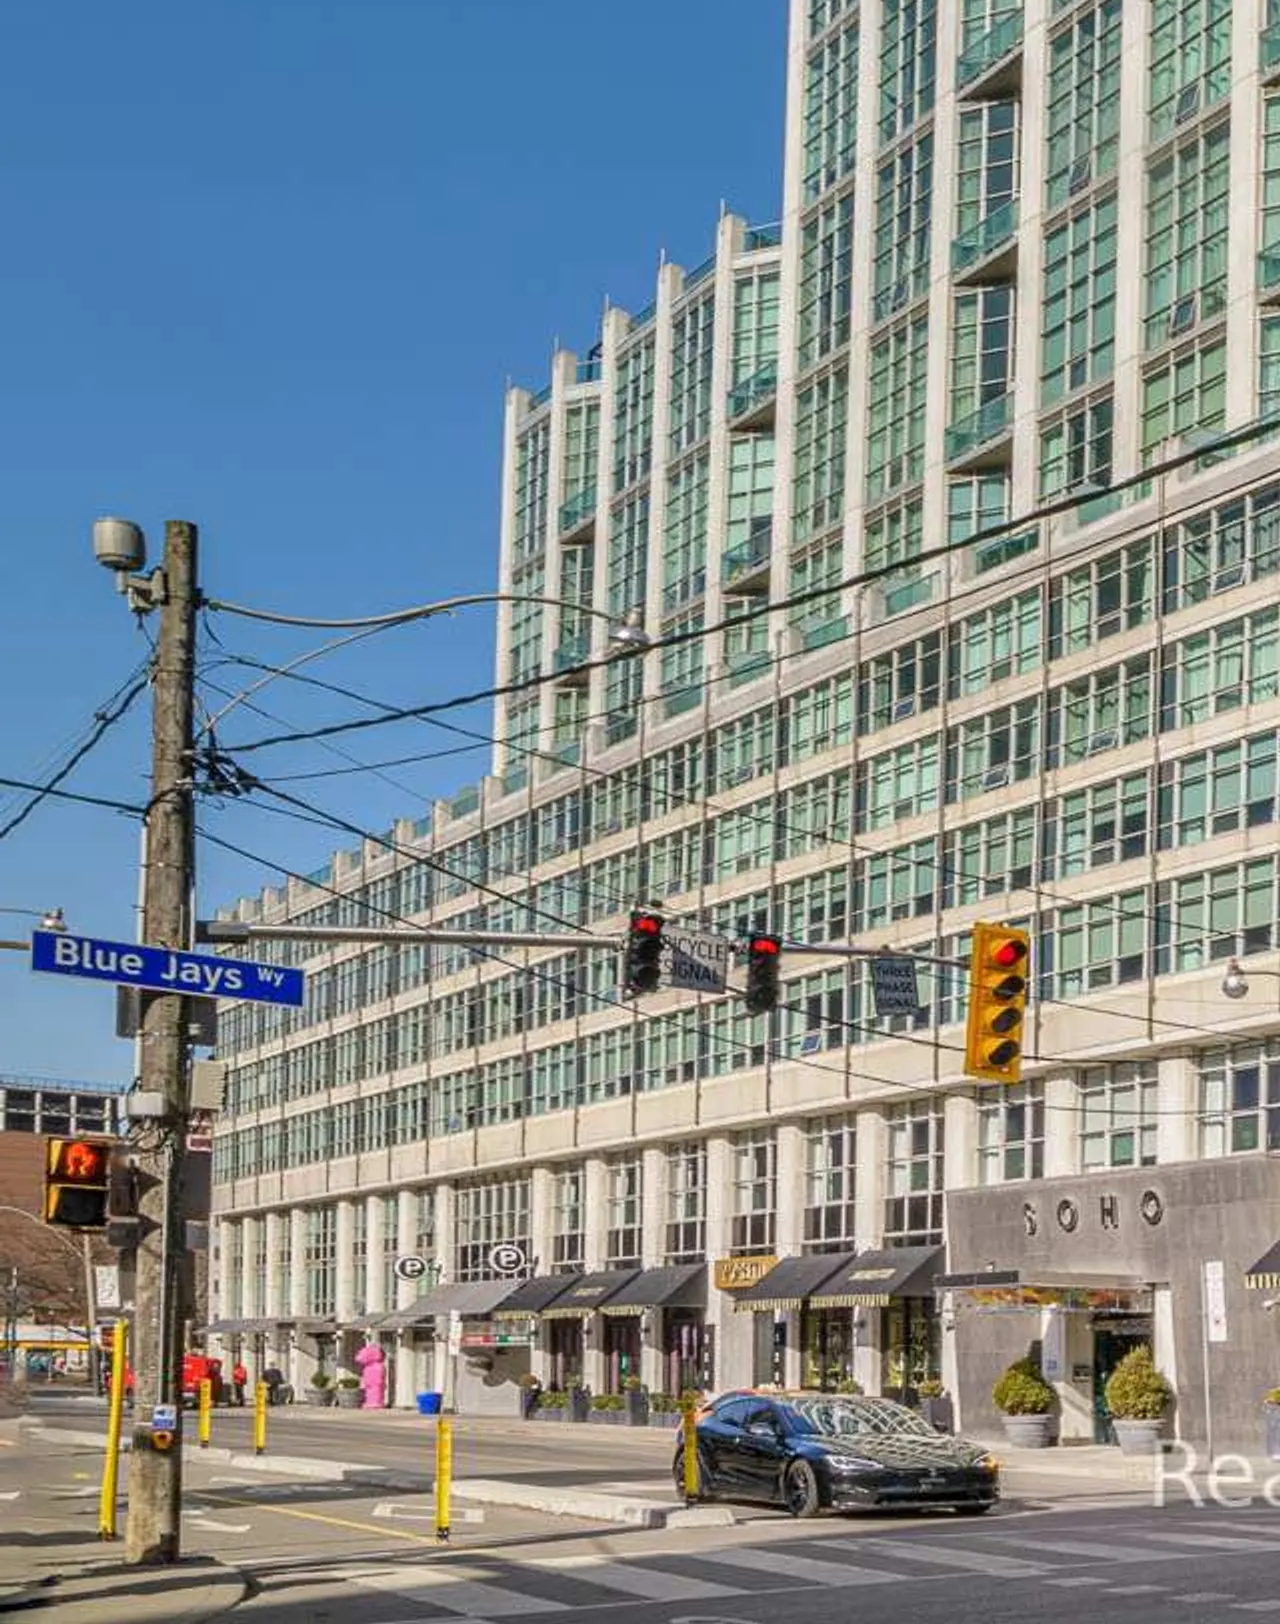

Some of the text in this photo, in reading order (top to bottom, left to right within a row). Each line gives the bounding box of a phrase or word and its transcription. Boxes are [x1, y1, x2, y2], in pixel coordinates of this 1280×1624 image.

[54, 938, 285, 992] Blue Jays Wy
[664, 959, 718, 985] SIGNAL
[1024, 1190, 1163, 1236] SOHO
